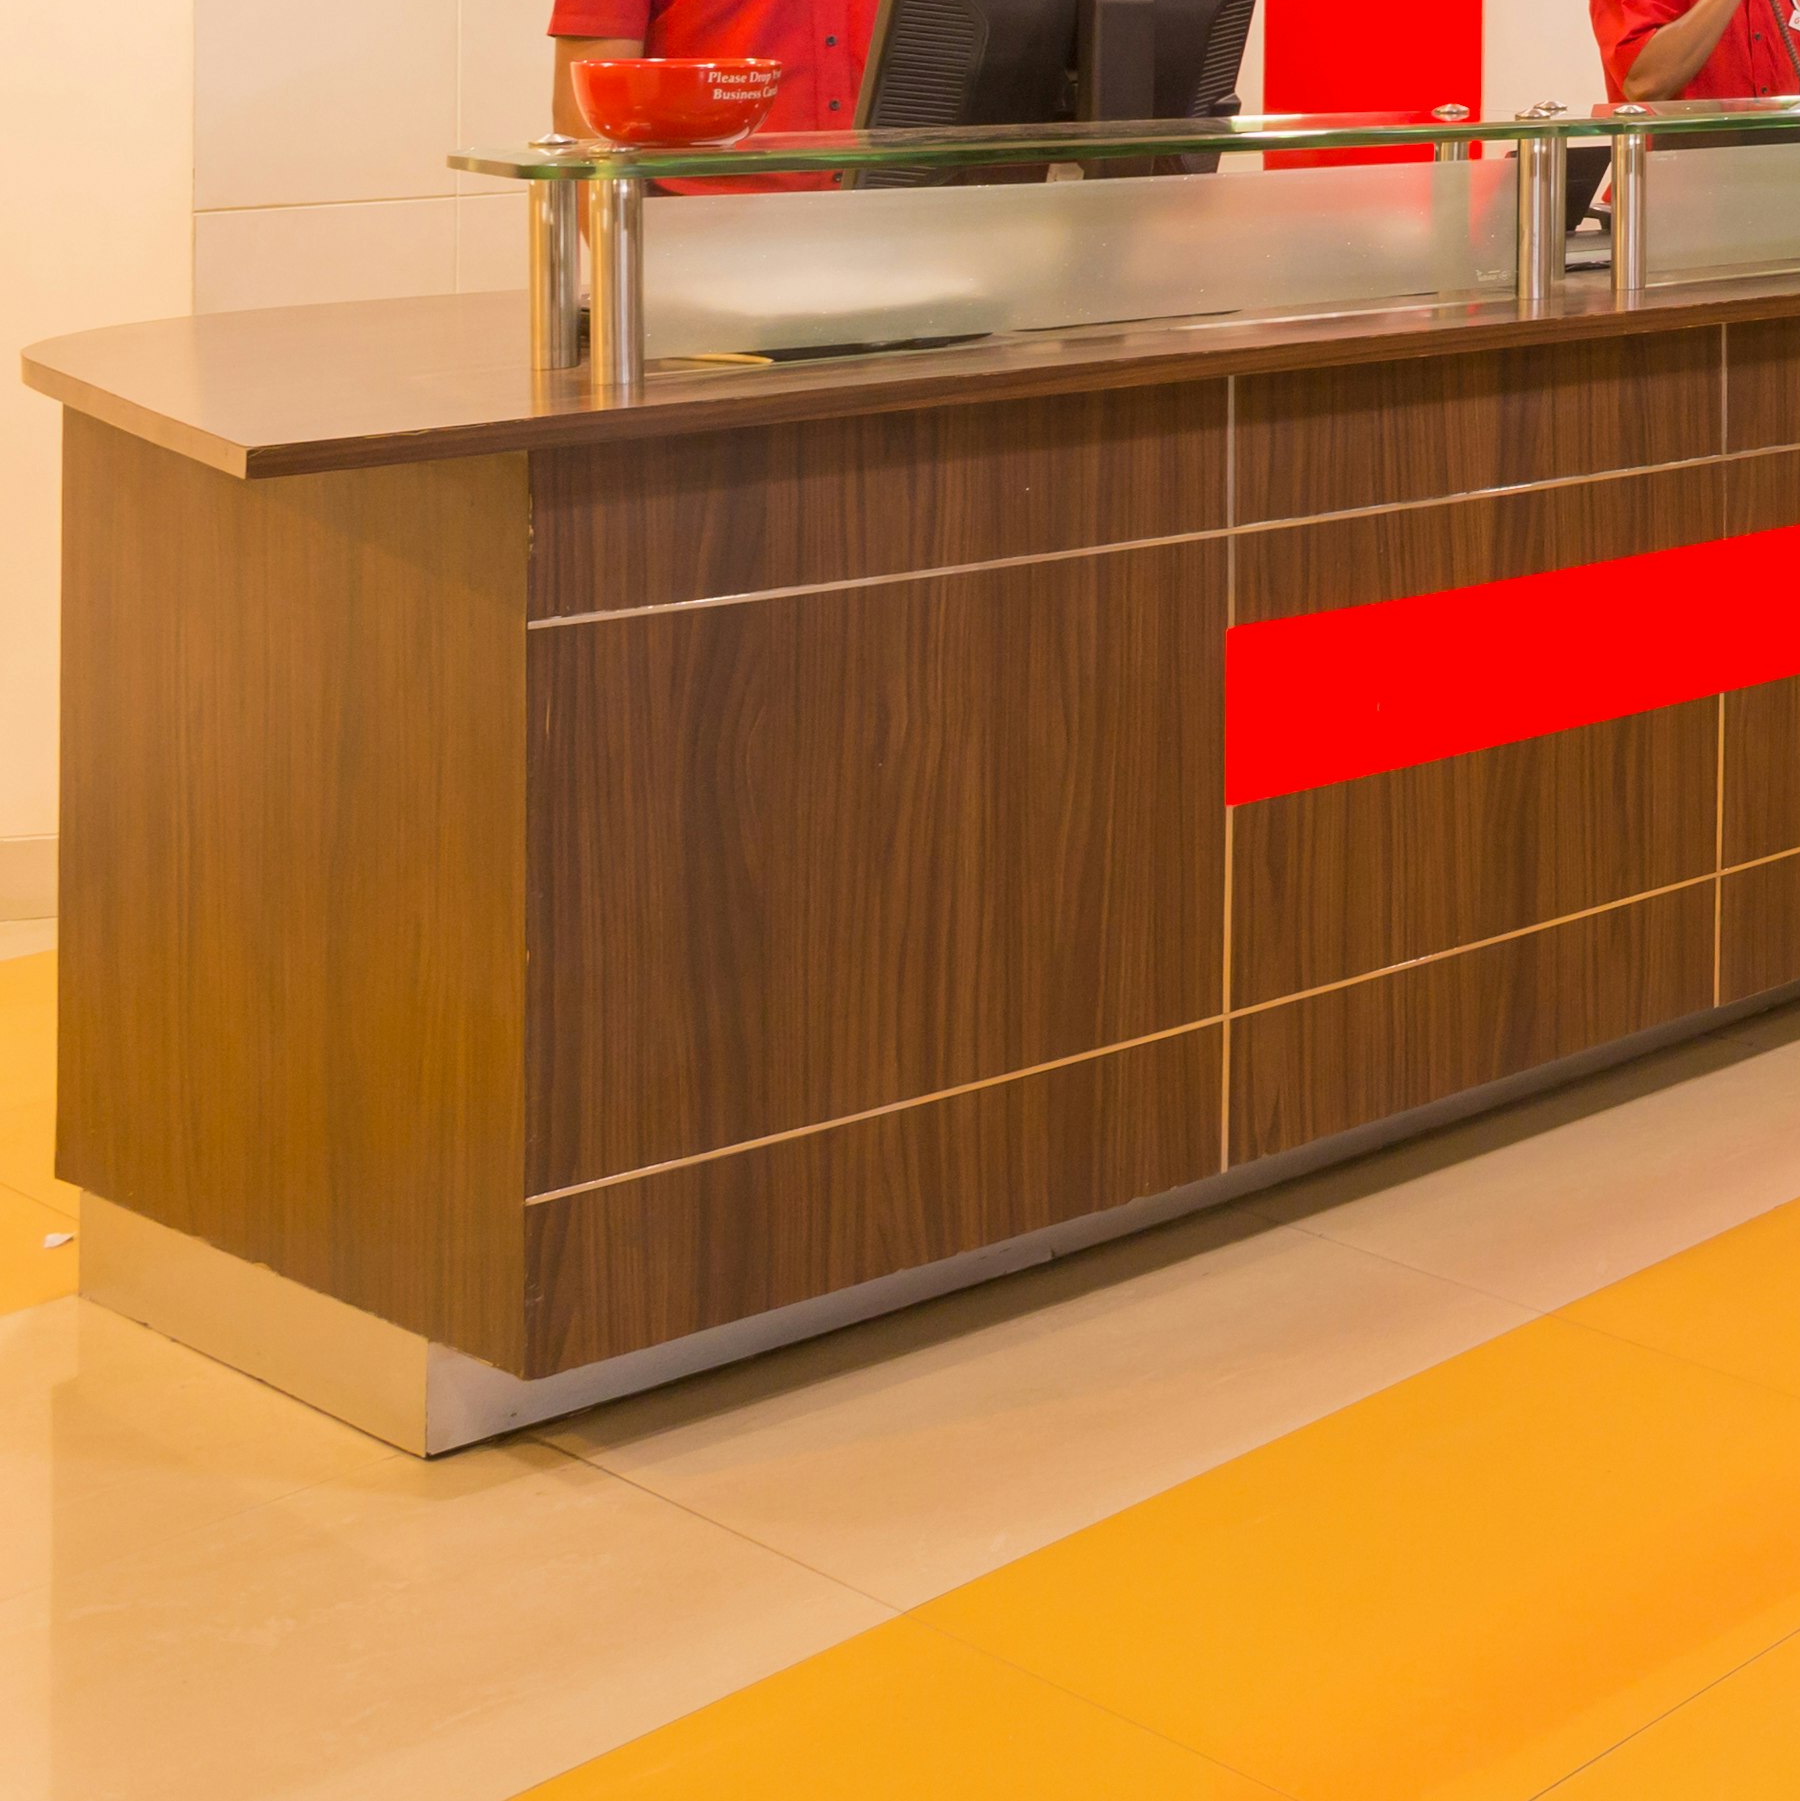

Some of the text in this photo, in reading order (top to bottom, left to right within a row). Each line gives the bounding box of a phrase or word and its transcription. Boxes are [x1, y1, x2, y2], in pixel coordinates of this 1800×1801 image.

[707, 71, 748, 83] Please
[749, 71, 772, 84] Drop
[713, 88, 761, 100] Business
